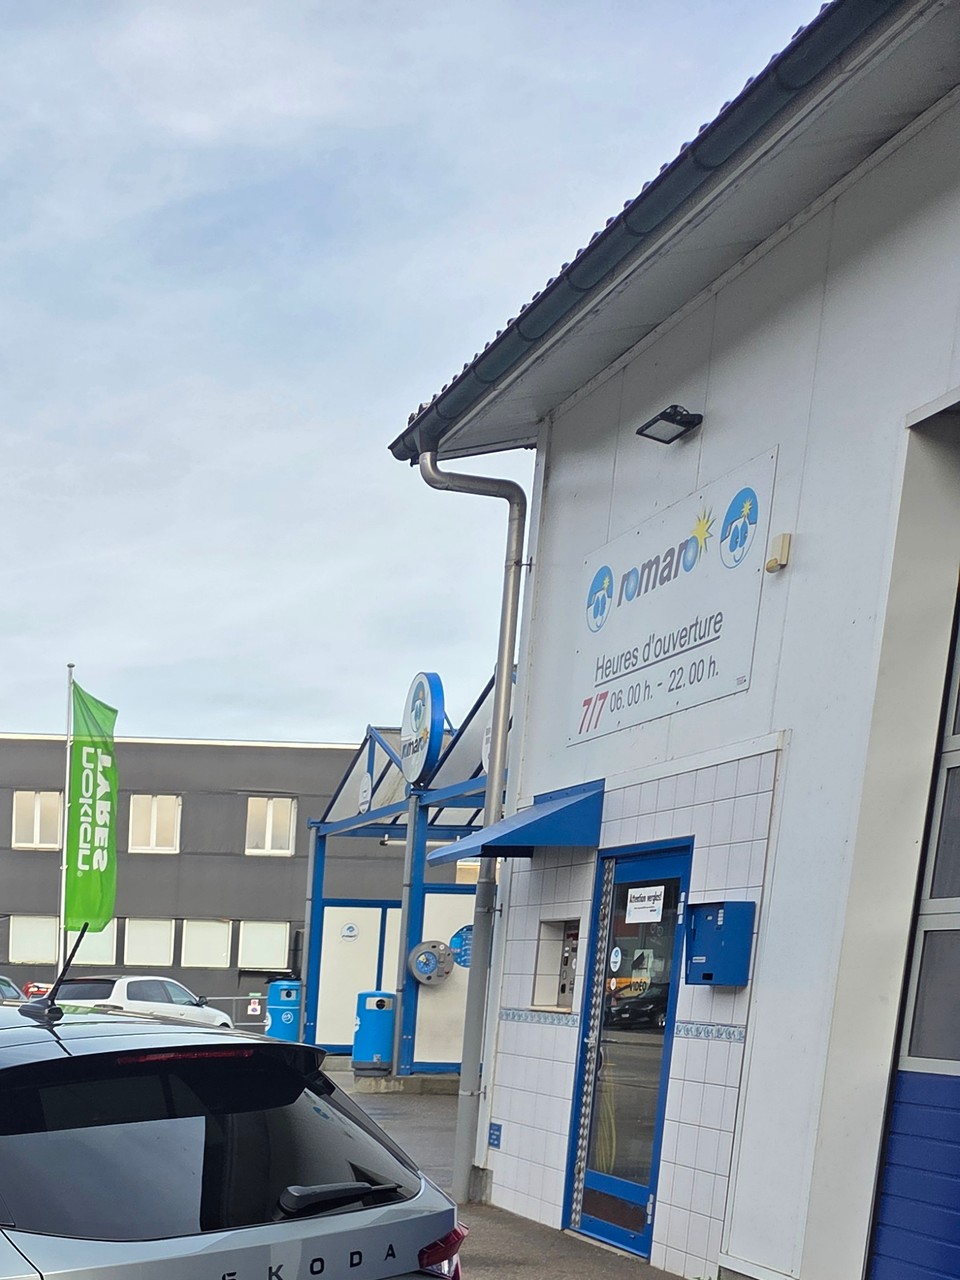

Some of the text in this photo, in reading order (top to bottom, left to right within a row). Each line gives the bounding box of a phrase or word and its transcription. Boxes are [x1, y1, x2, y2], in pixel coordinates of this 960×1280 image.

[617, 535, 700, 608] romaro
[595, 611, 723, 682] Heures d'ouverture
[578, 690, 609, 735] 7/7
